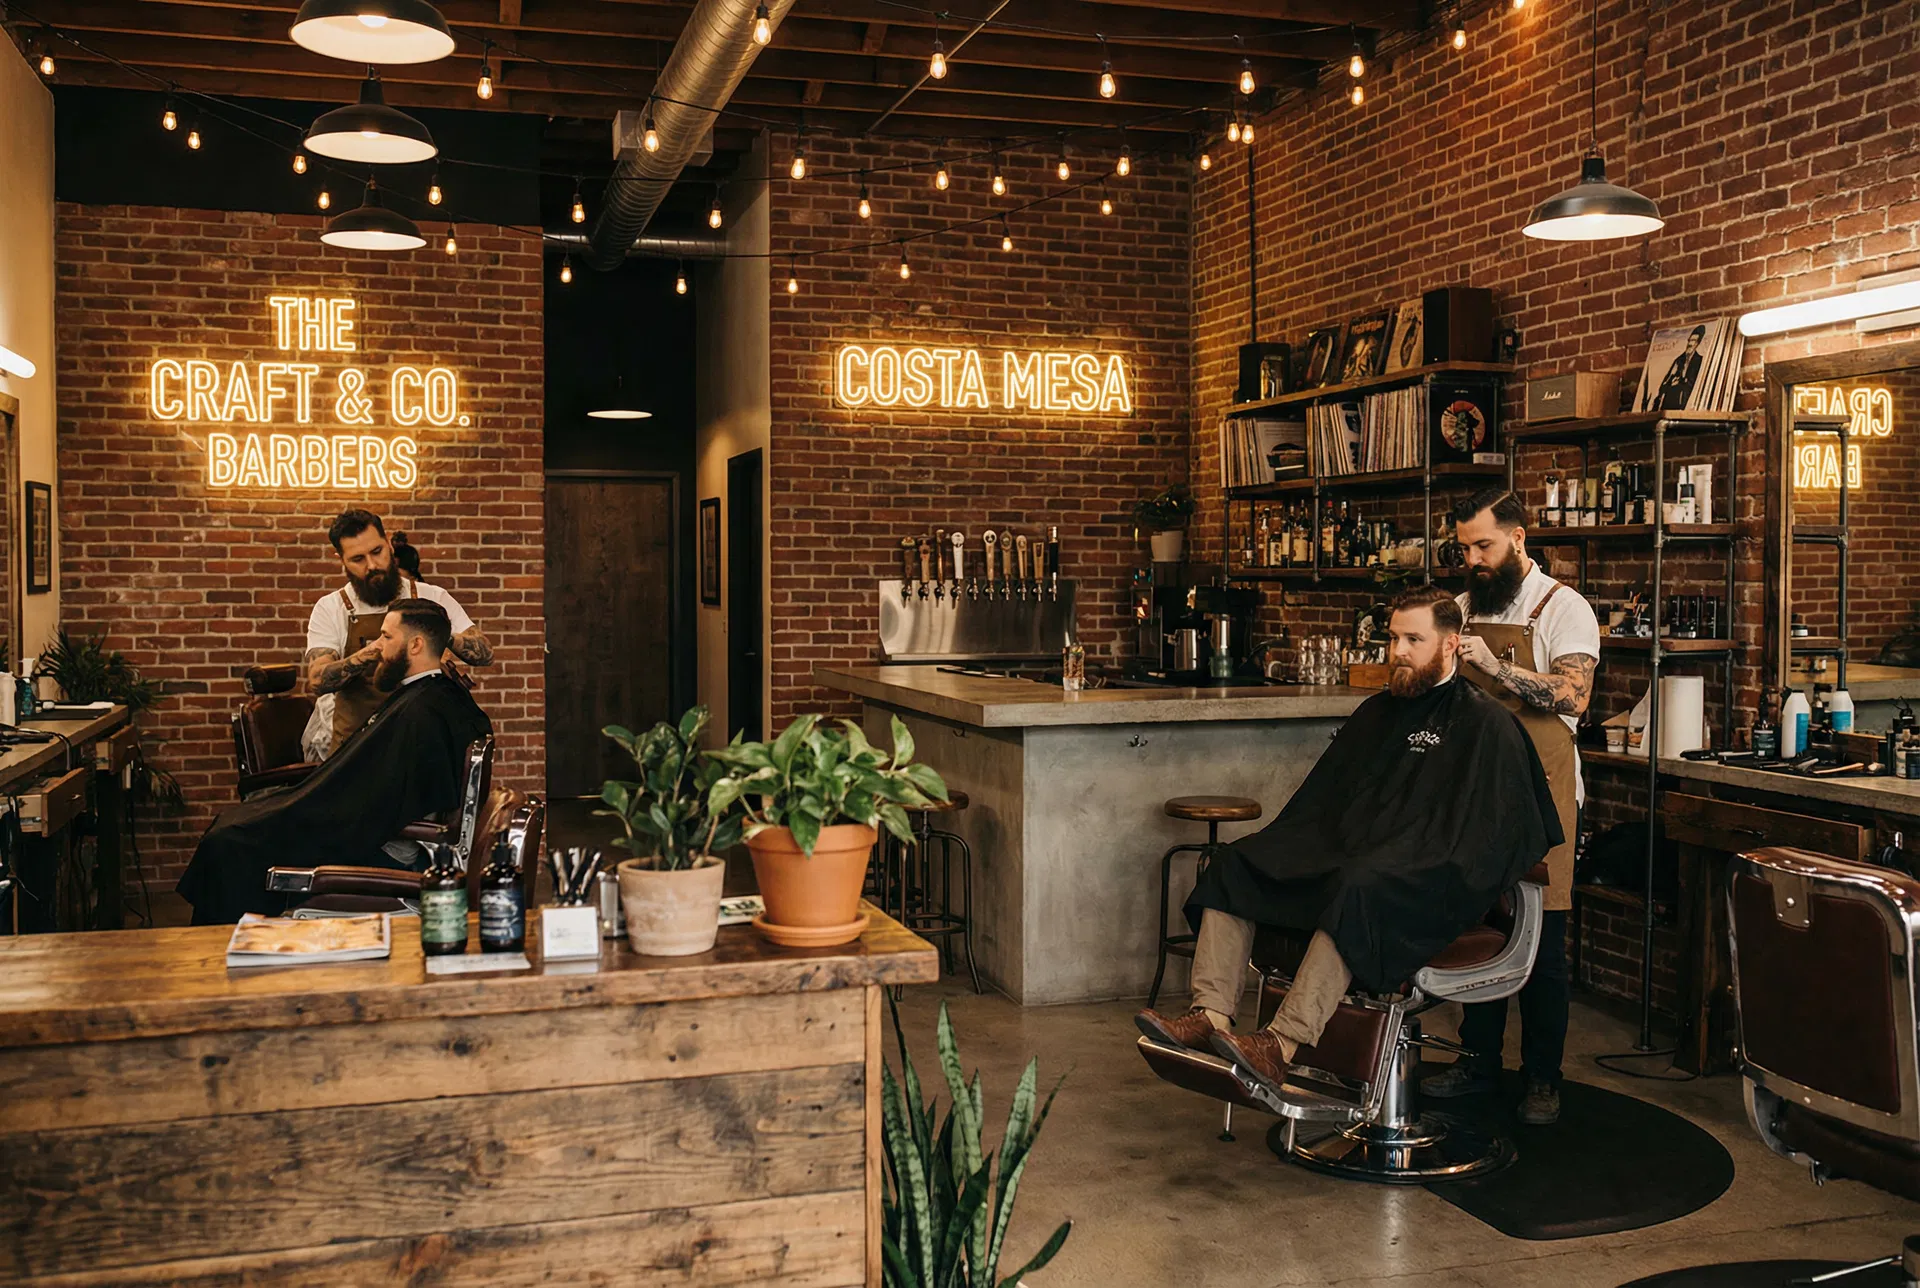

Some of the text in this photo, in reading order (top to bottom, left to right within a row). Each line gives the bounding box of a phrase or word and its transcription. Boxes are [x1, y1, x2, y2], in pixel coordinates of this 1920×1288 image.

[269, 295, 357, 352] THE
[150, 358, 471, 427] CRAFT & CO.
[837, 345, 1132, 412] COSTA MESA
[207, 432, 418, 489] BARBERS
